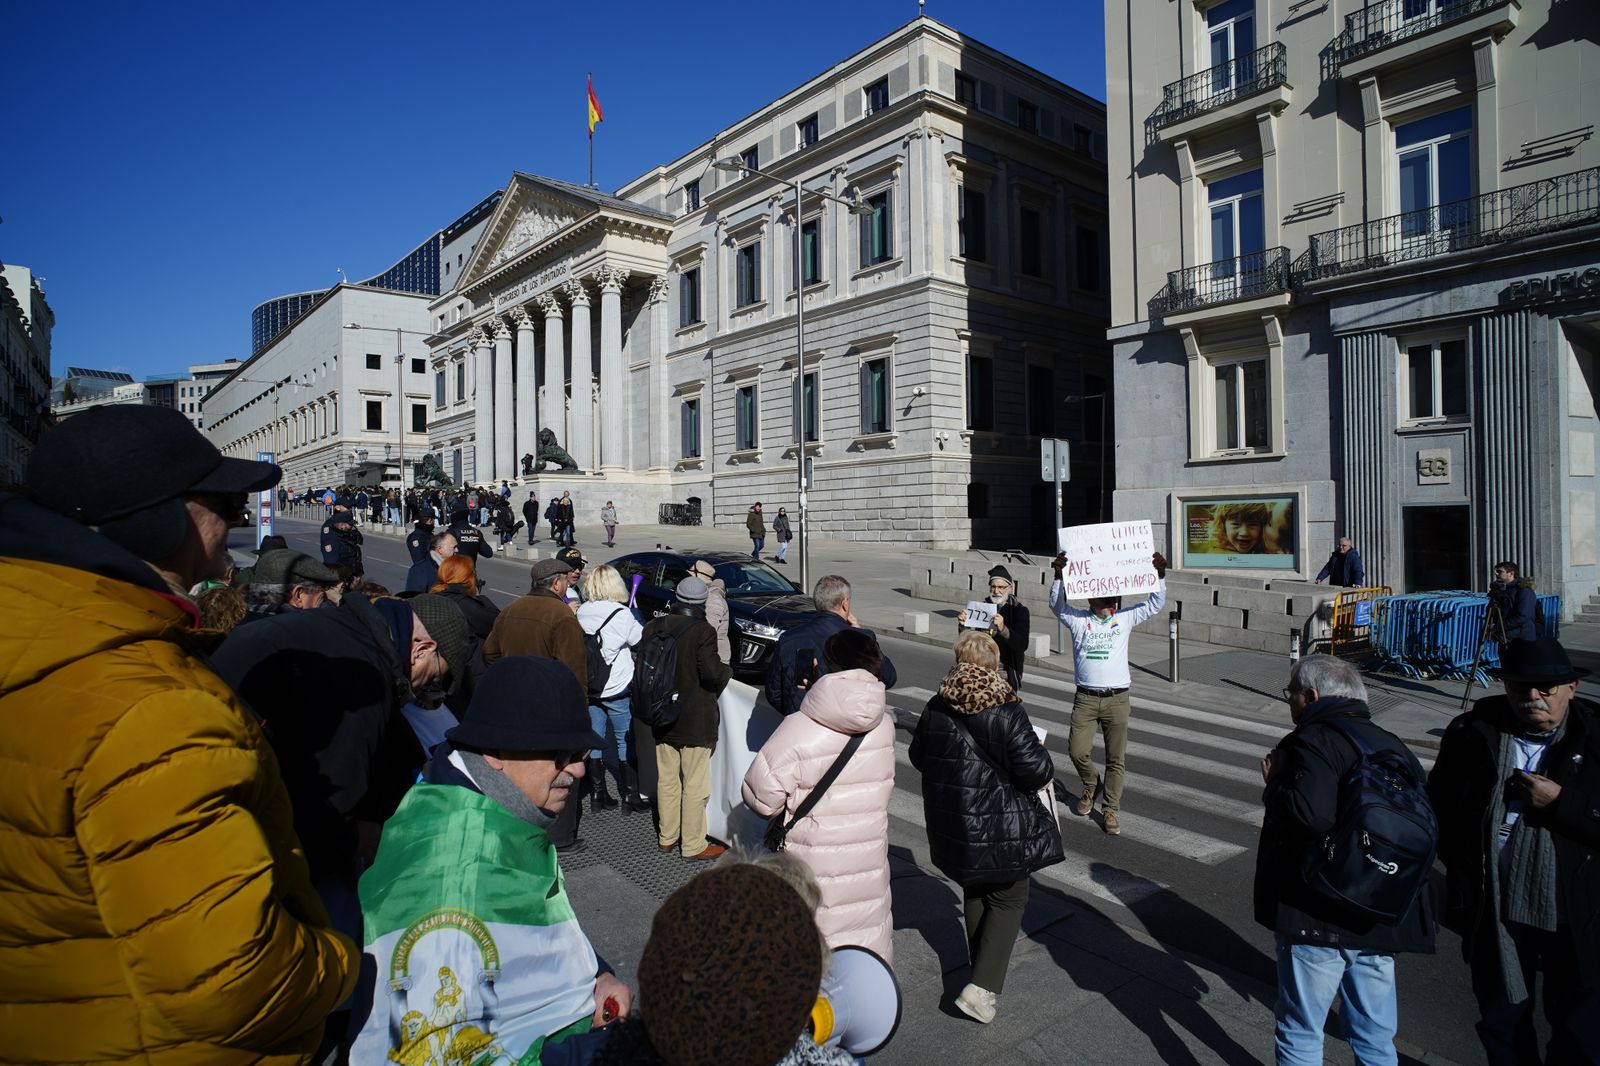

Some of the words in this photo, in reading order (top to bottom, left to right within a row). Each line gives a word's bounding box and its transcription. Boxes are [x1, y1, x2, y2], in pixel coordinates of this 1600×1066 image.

[499, 289, 519, 305] CONGRESO
[521, 284, 528, 294] DE
[529, 279, 538, 291] LOS
[540, 265, 566, 284] DIPUTADOS
[1068, 559, 1092, 577] AVE
[967, 608, 989, 623] 772
